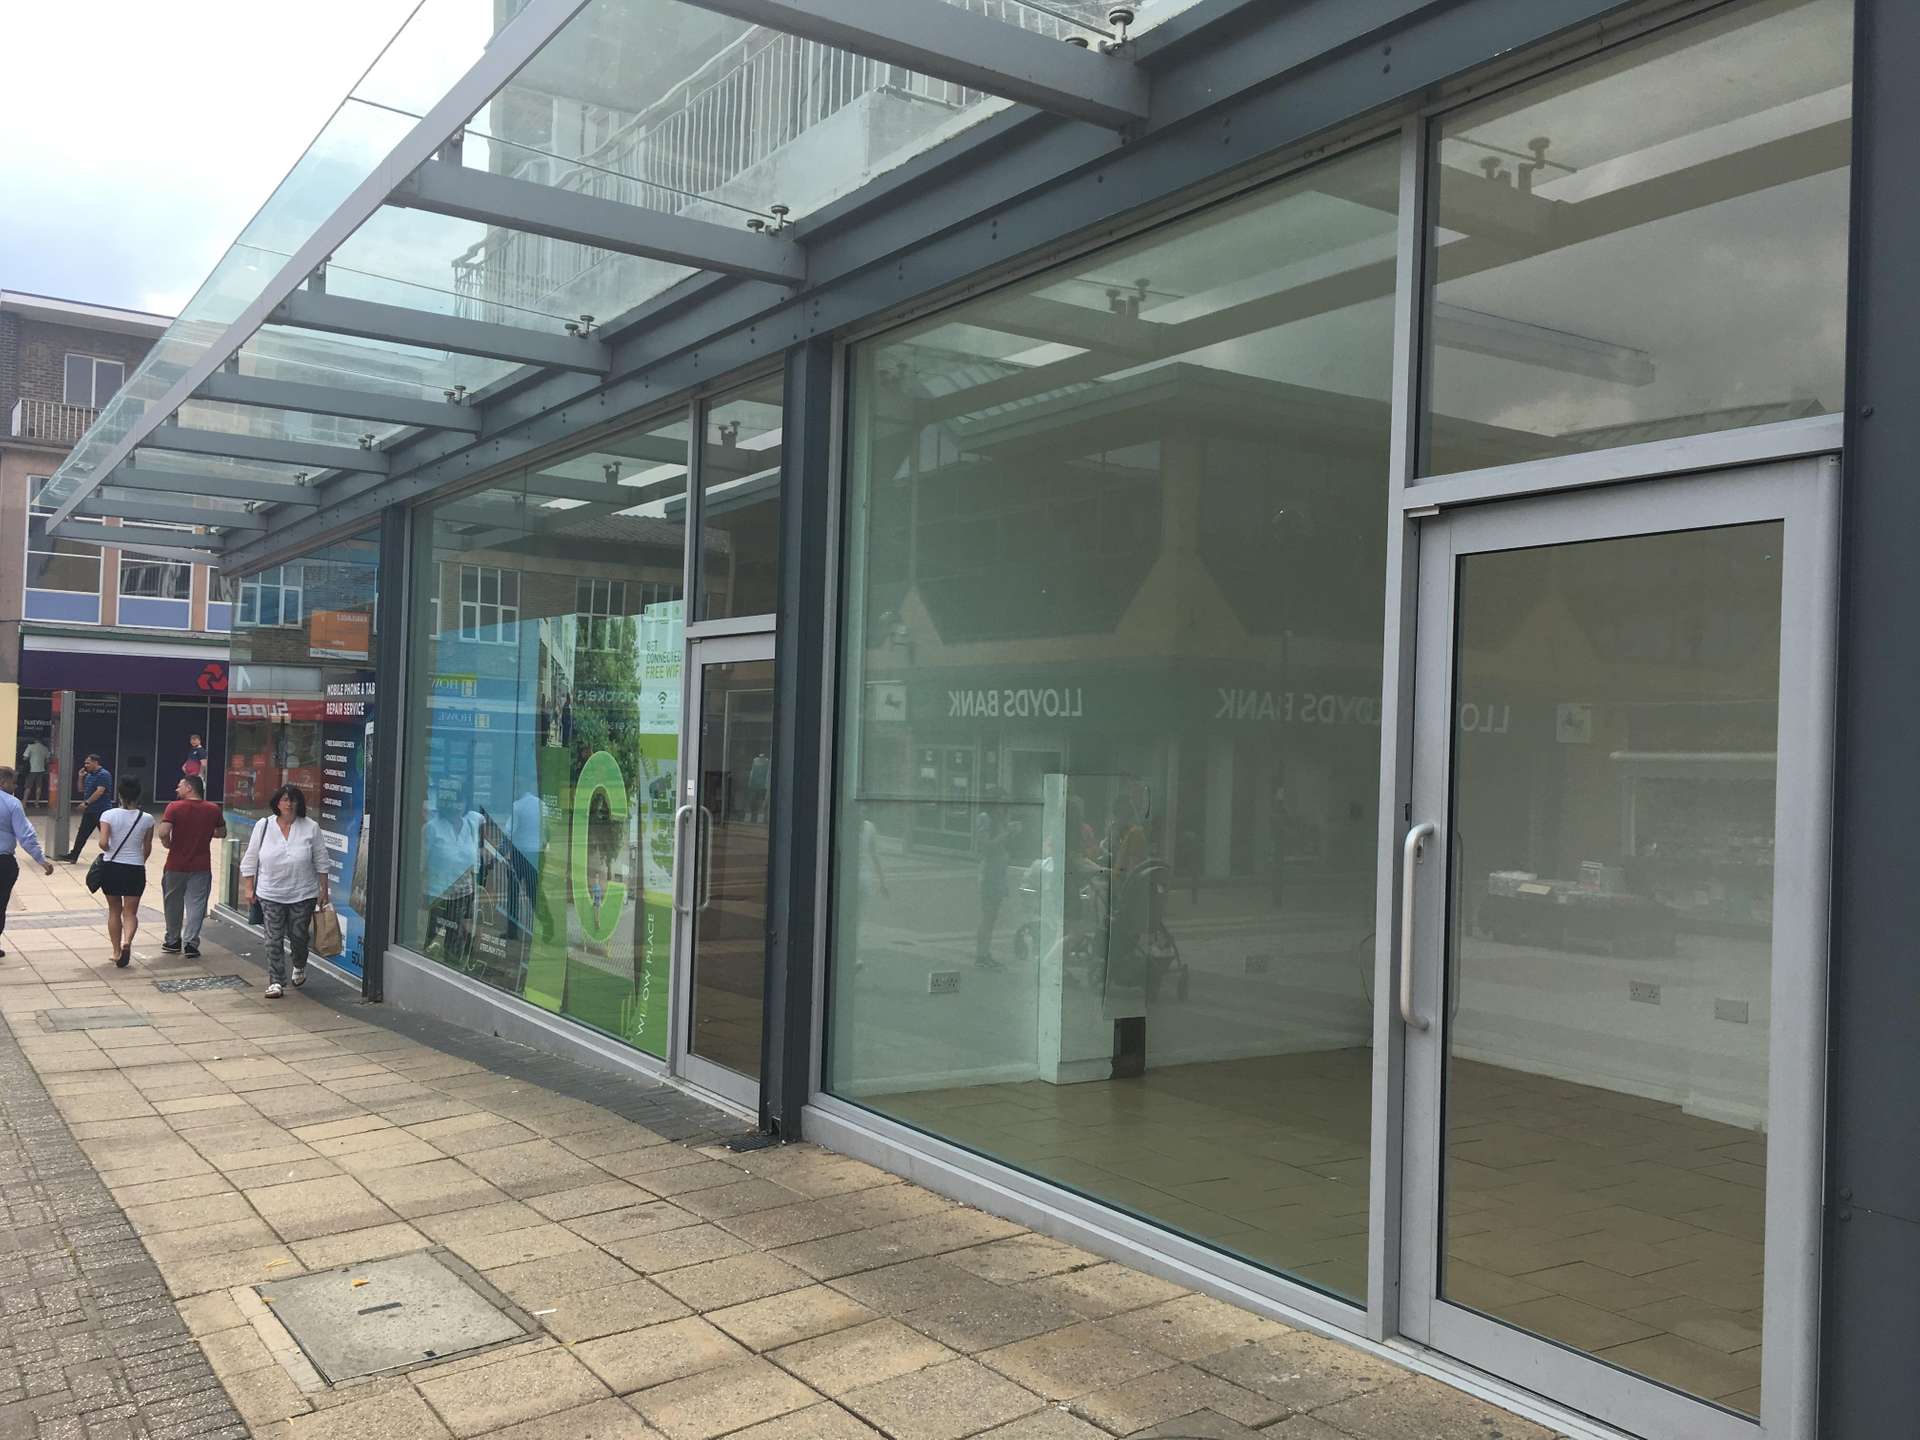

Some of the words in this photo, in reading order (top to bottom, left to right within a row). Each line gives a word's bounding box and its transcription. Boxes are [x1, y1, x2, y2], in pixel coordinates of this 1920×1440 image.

[645, 664, 664, 679] FREE
[665, 663, 681, 679] WIF
[327, 683, 343, 696] MOBILE
[344, 682, 360, 695] PHONE
[326, 702, 343, 715] REPAIR
[344, 702, 365, 715] SERVICE
[645, 912, 655, 965] PLACE
